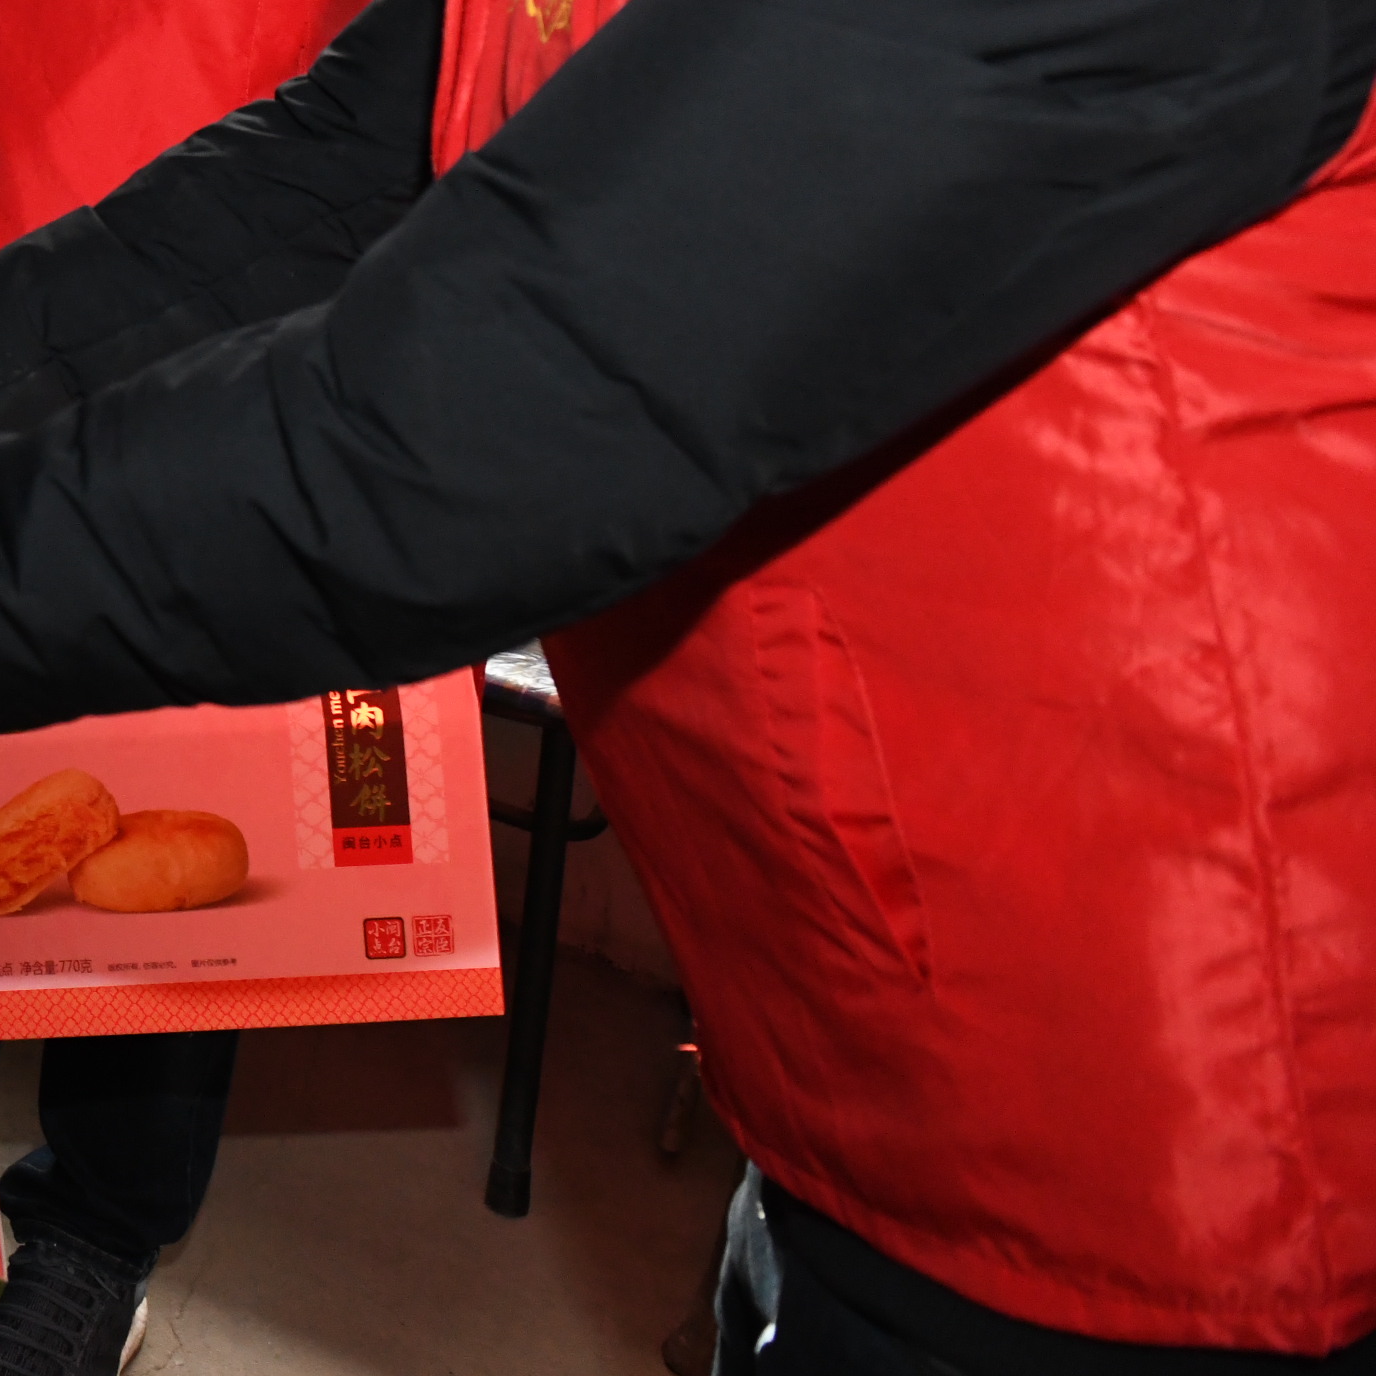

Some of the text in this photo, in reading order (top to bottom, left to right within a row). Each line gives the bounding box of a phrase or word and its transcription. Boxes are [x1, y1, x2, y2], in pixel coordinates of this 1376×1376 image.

[342, 834, 403, 850] 闽台小点
[19, 959, 93, 977] 净含量:770克
